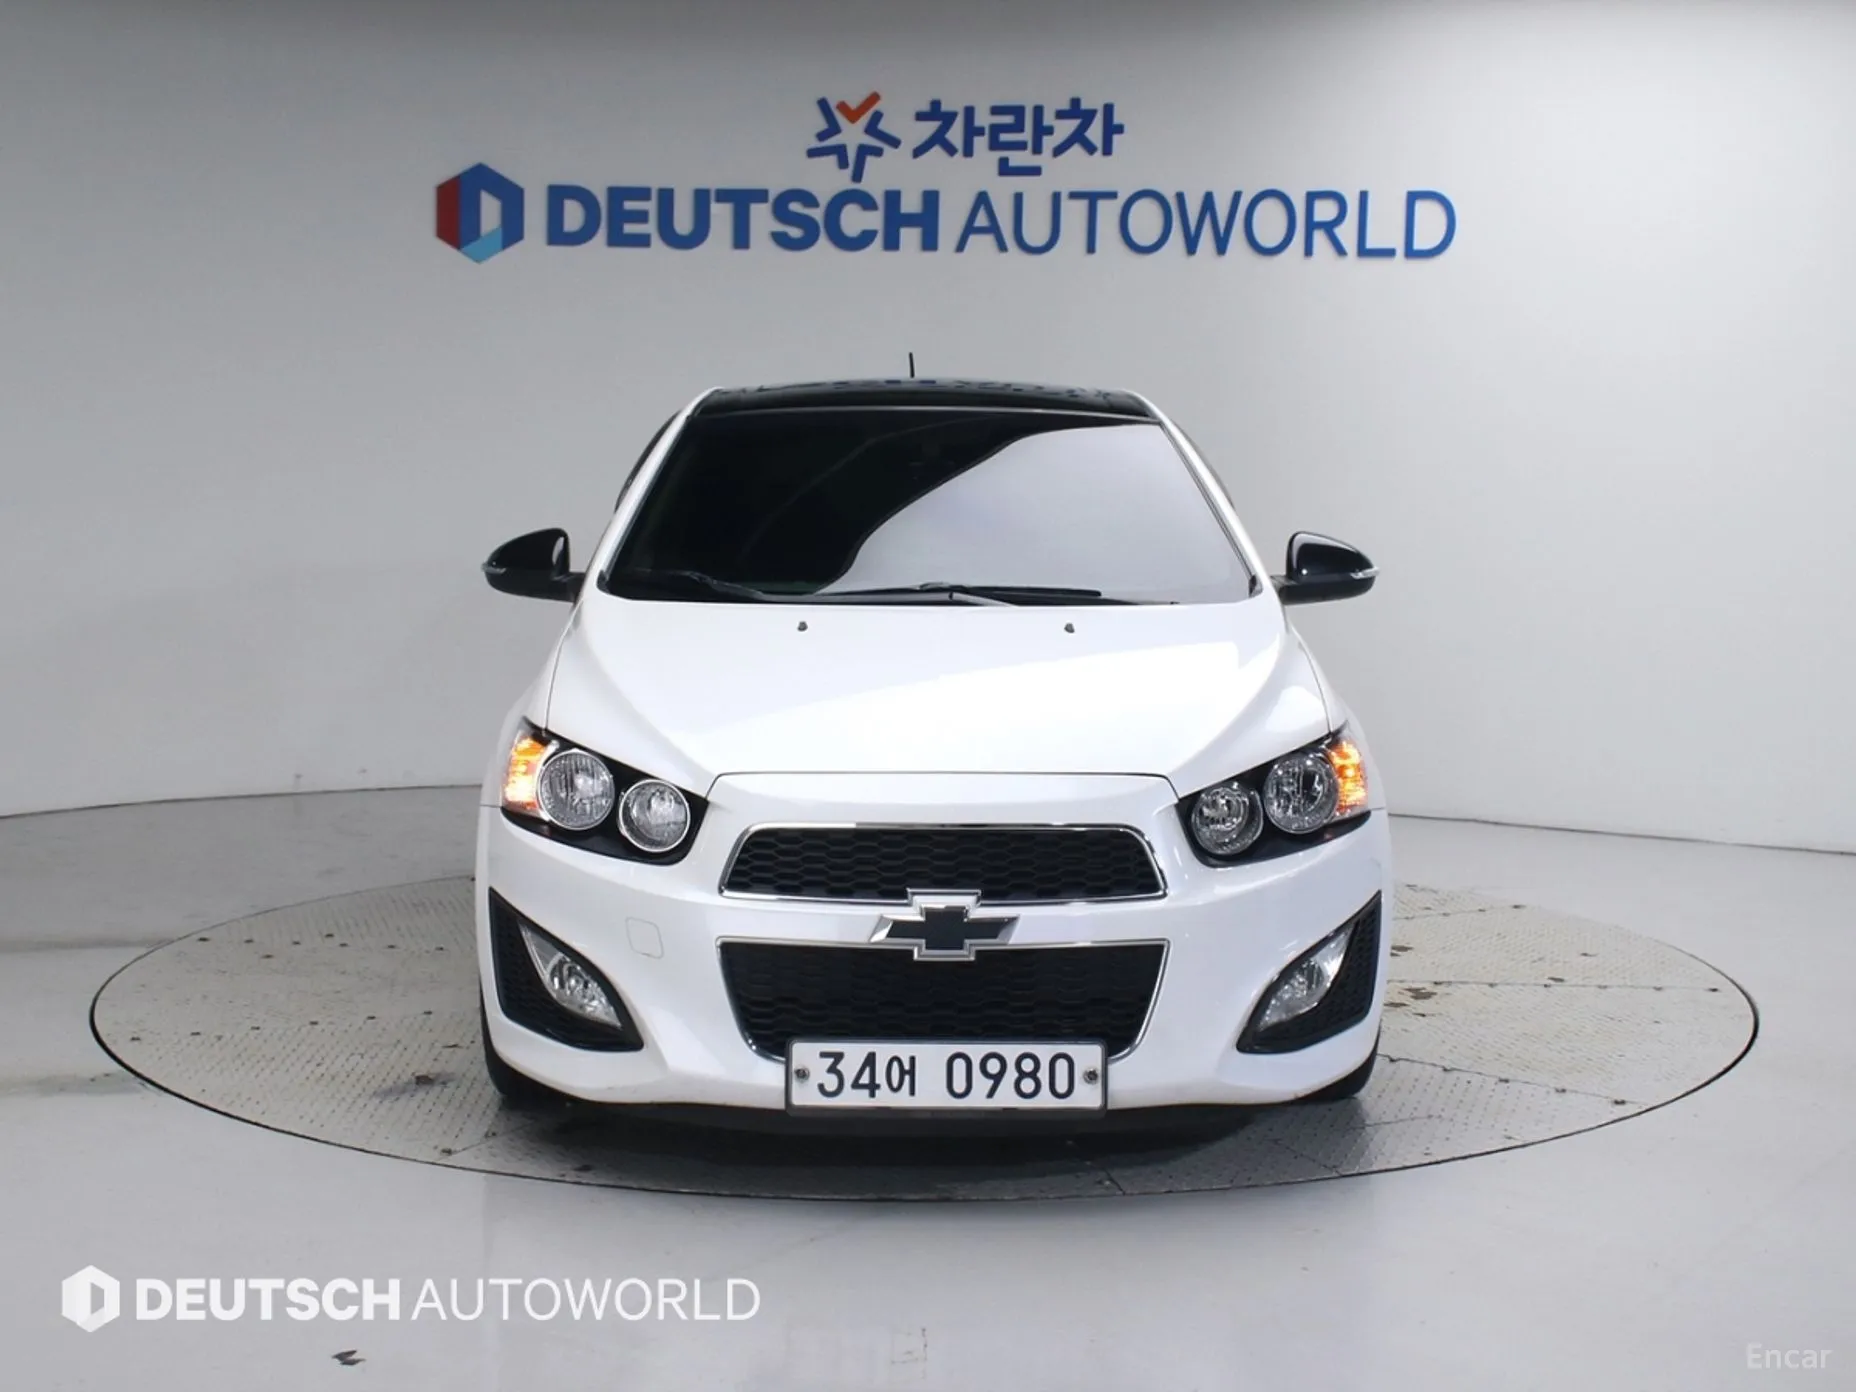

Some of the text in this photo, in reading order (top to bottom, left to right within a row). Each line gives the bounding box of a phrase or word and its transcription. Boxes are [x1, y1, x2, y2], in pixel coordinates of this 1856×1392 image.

[912, 97, 1125, 177] 차란차
[546, 184, 1457, 259] DEUTSCH AUTOWORLD
[816, 1051, 1075, 1100] 34어 0980
